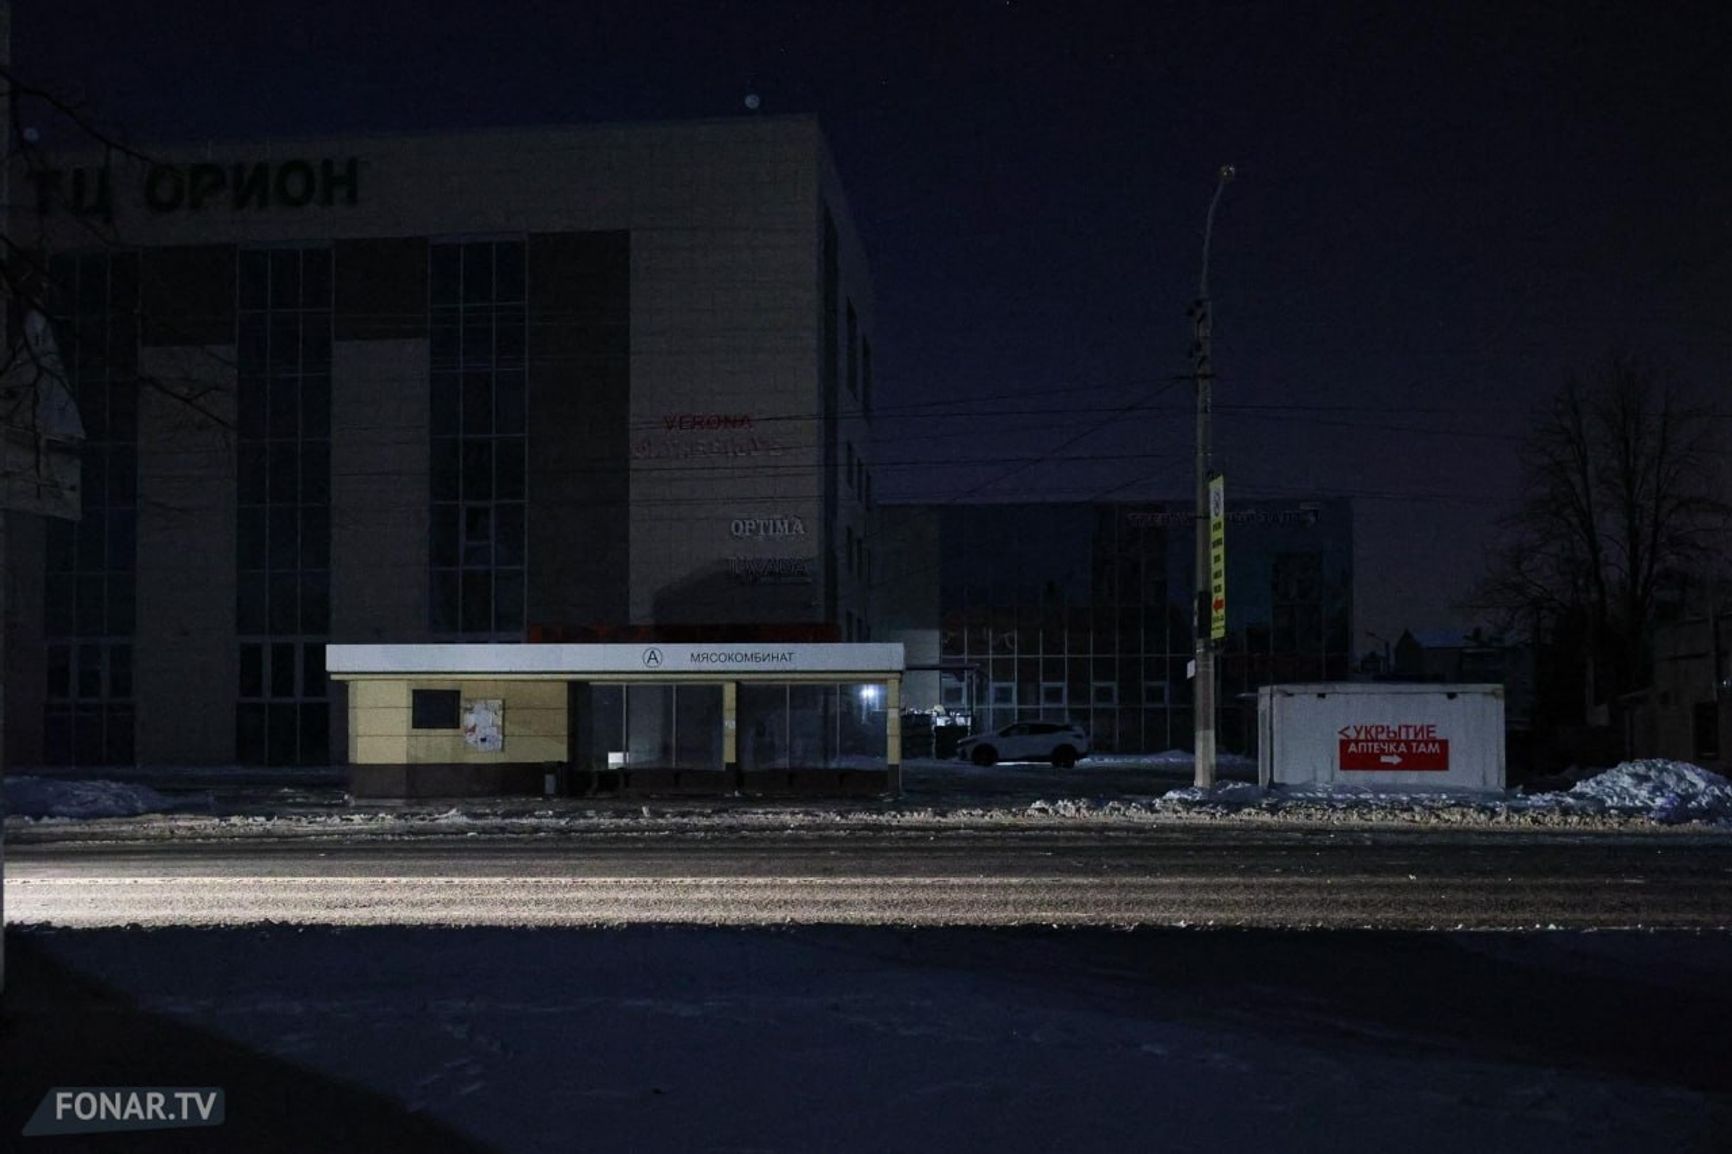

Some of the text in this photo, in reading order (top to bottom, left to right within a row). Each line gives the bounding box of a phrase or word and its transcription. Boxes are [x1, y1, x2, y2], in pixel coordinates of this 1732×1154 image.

[27, 158, 358, 222] ТЦ ОРИОН
[664, 415, 752, 430] VERONA
[730, 518, 805, 536] OPTIMA
[690, 652, 794, 663] МЯСОКОМБИНАТ
[1348, 742, 1440, 754] АПТЕЧКА ТАМ
